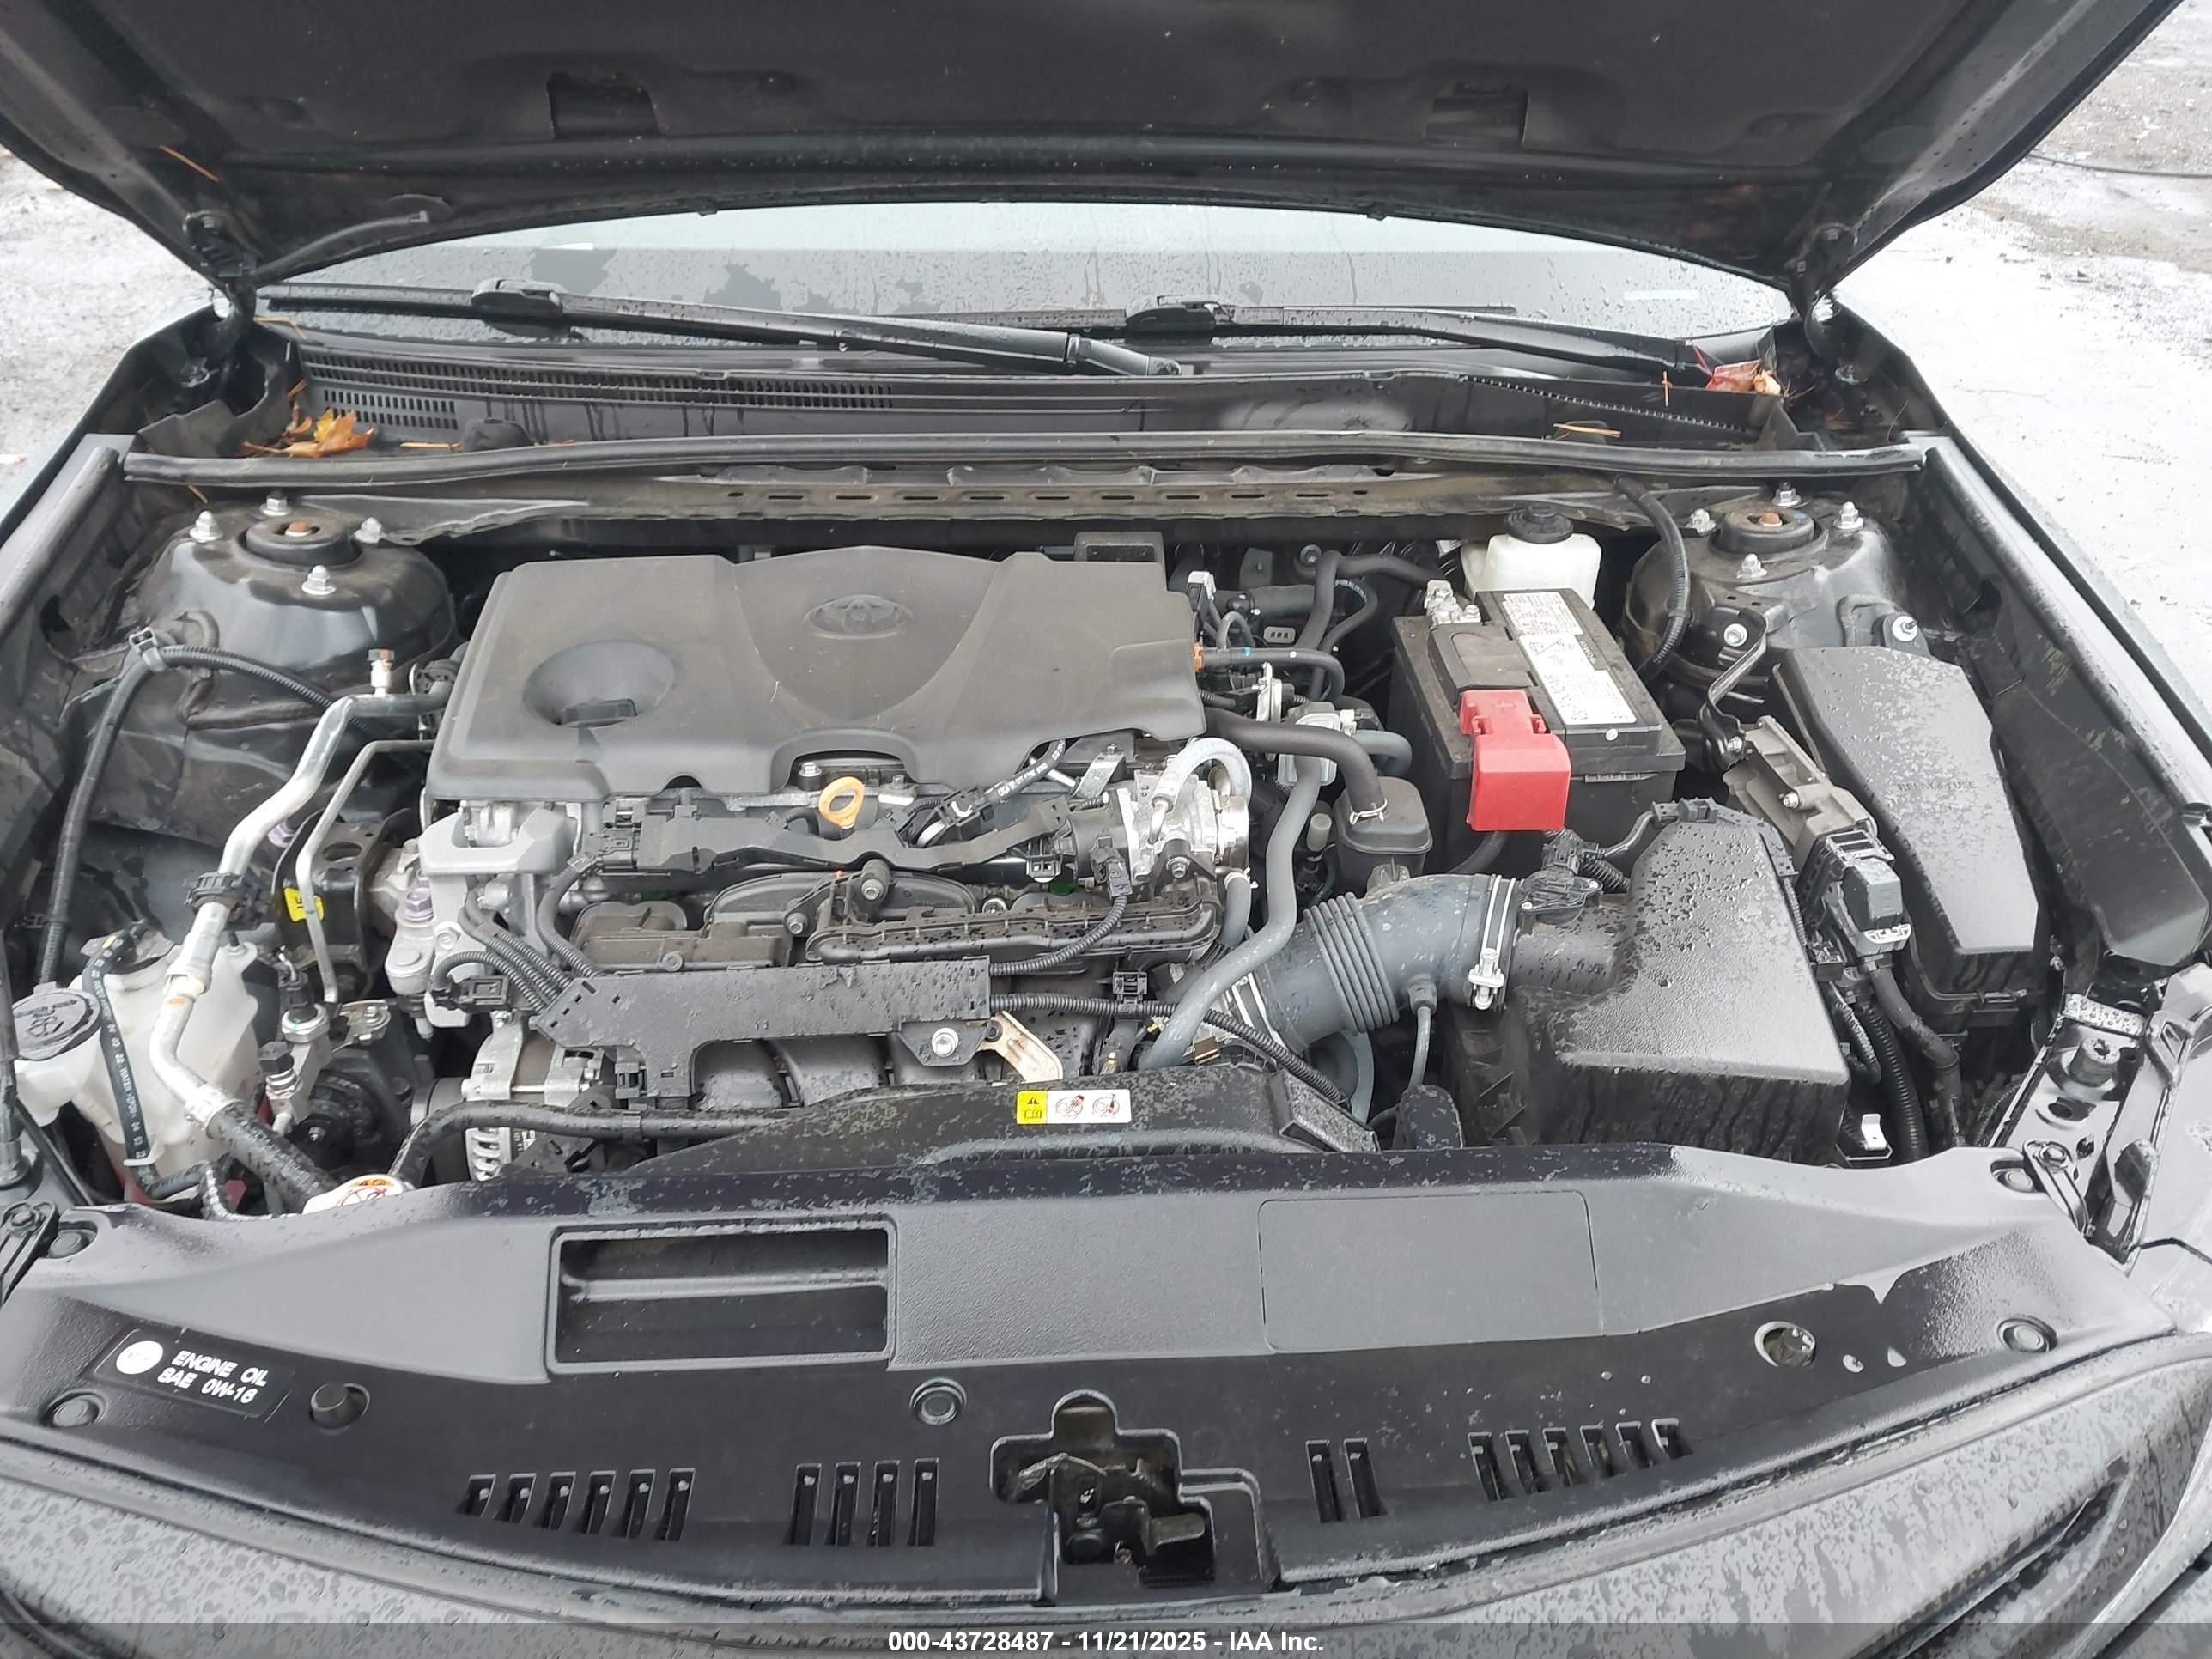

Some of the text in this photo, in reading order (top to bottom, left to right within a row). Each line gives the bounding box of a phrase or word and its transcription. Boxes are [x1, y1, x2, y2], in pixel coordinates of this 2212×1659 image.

[157, 1367, 258, 1404] SAE 0W-16
[172, 1350, 239, 1377] ENGINE
[240, 1367, 269, 1387] OIL
